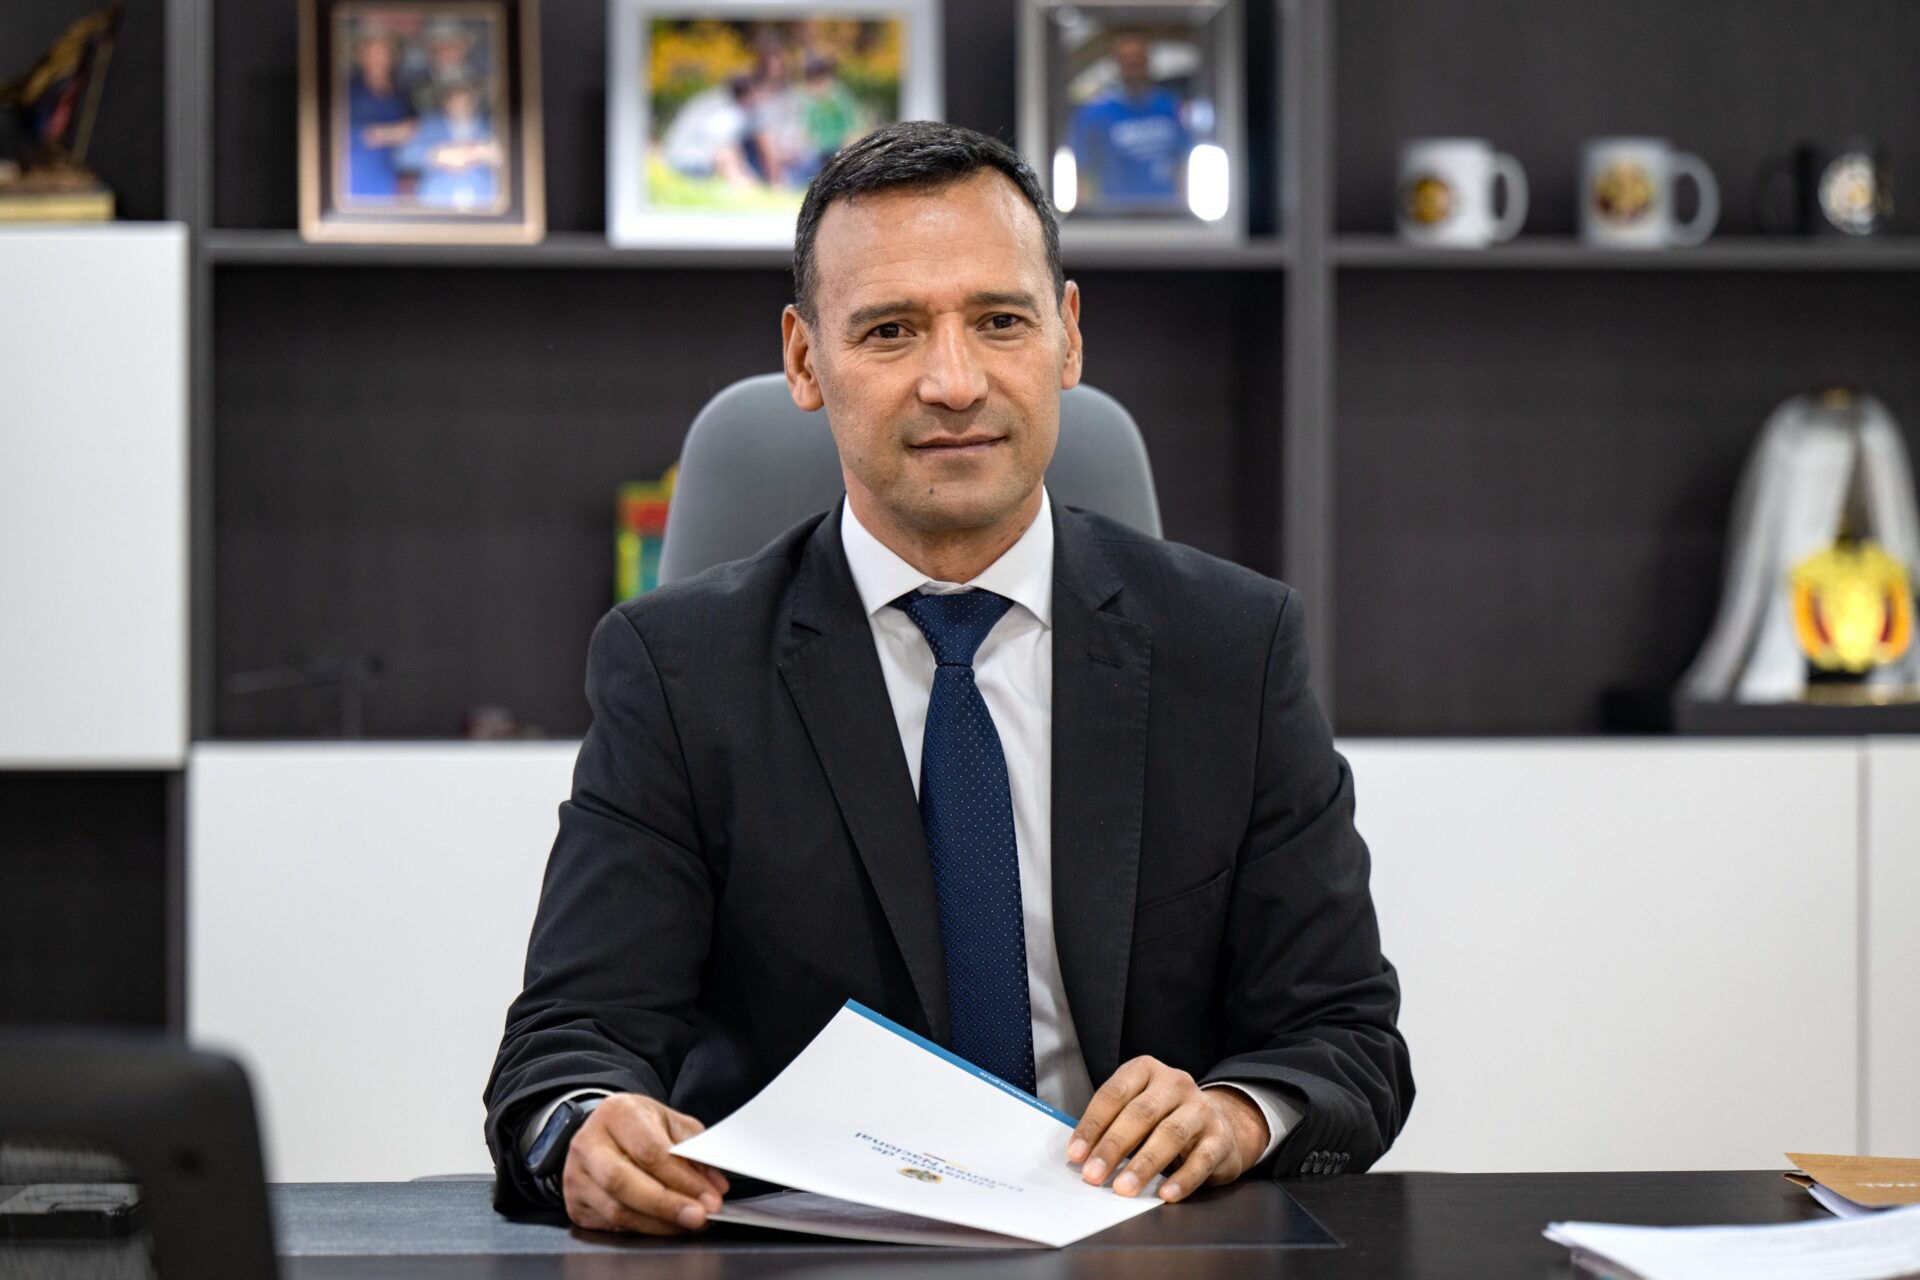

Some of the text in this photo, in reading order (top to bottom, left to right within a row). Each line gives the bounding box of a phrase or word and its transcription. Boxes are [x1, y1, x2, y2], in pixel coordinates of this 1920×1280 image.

[854, 1131, 1024, 1192] Defensa Nacional
[871, 1145, 995, 1189] Ministerio de
